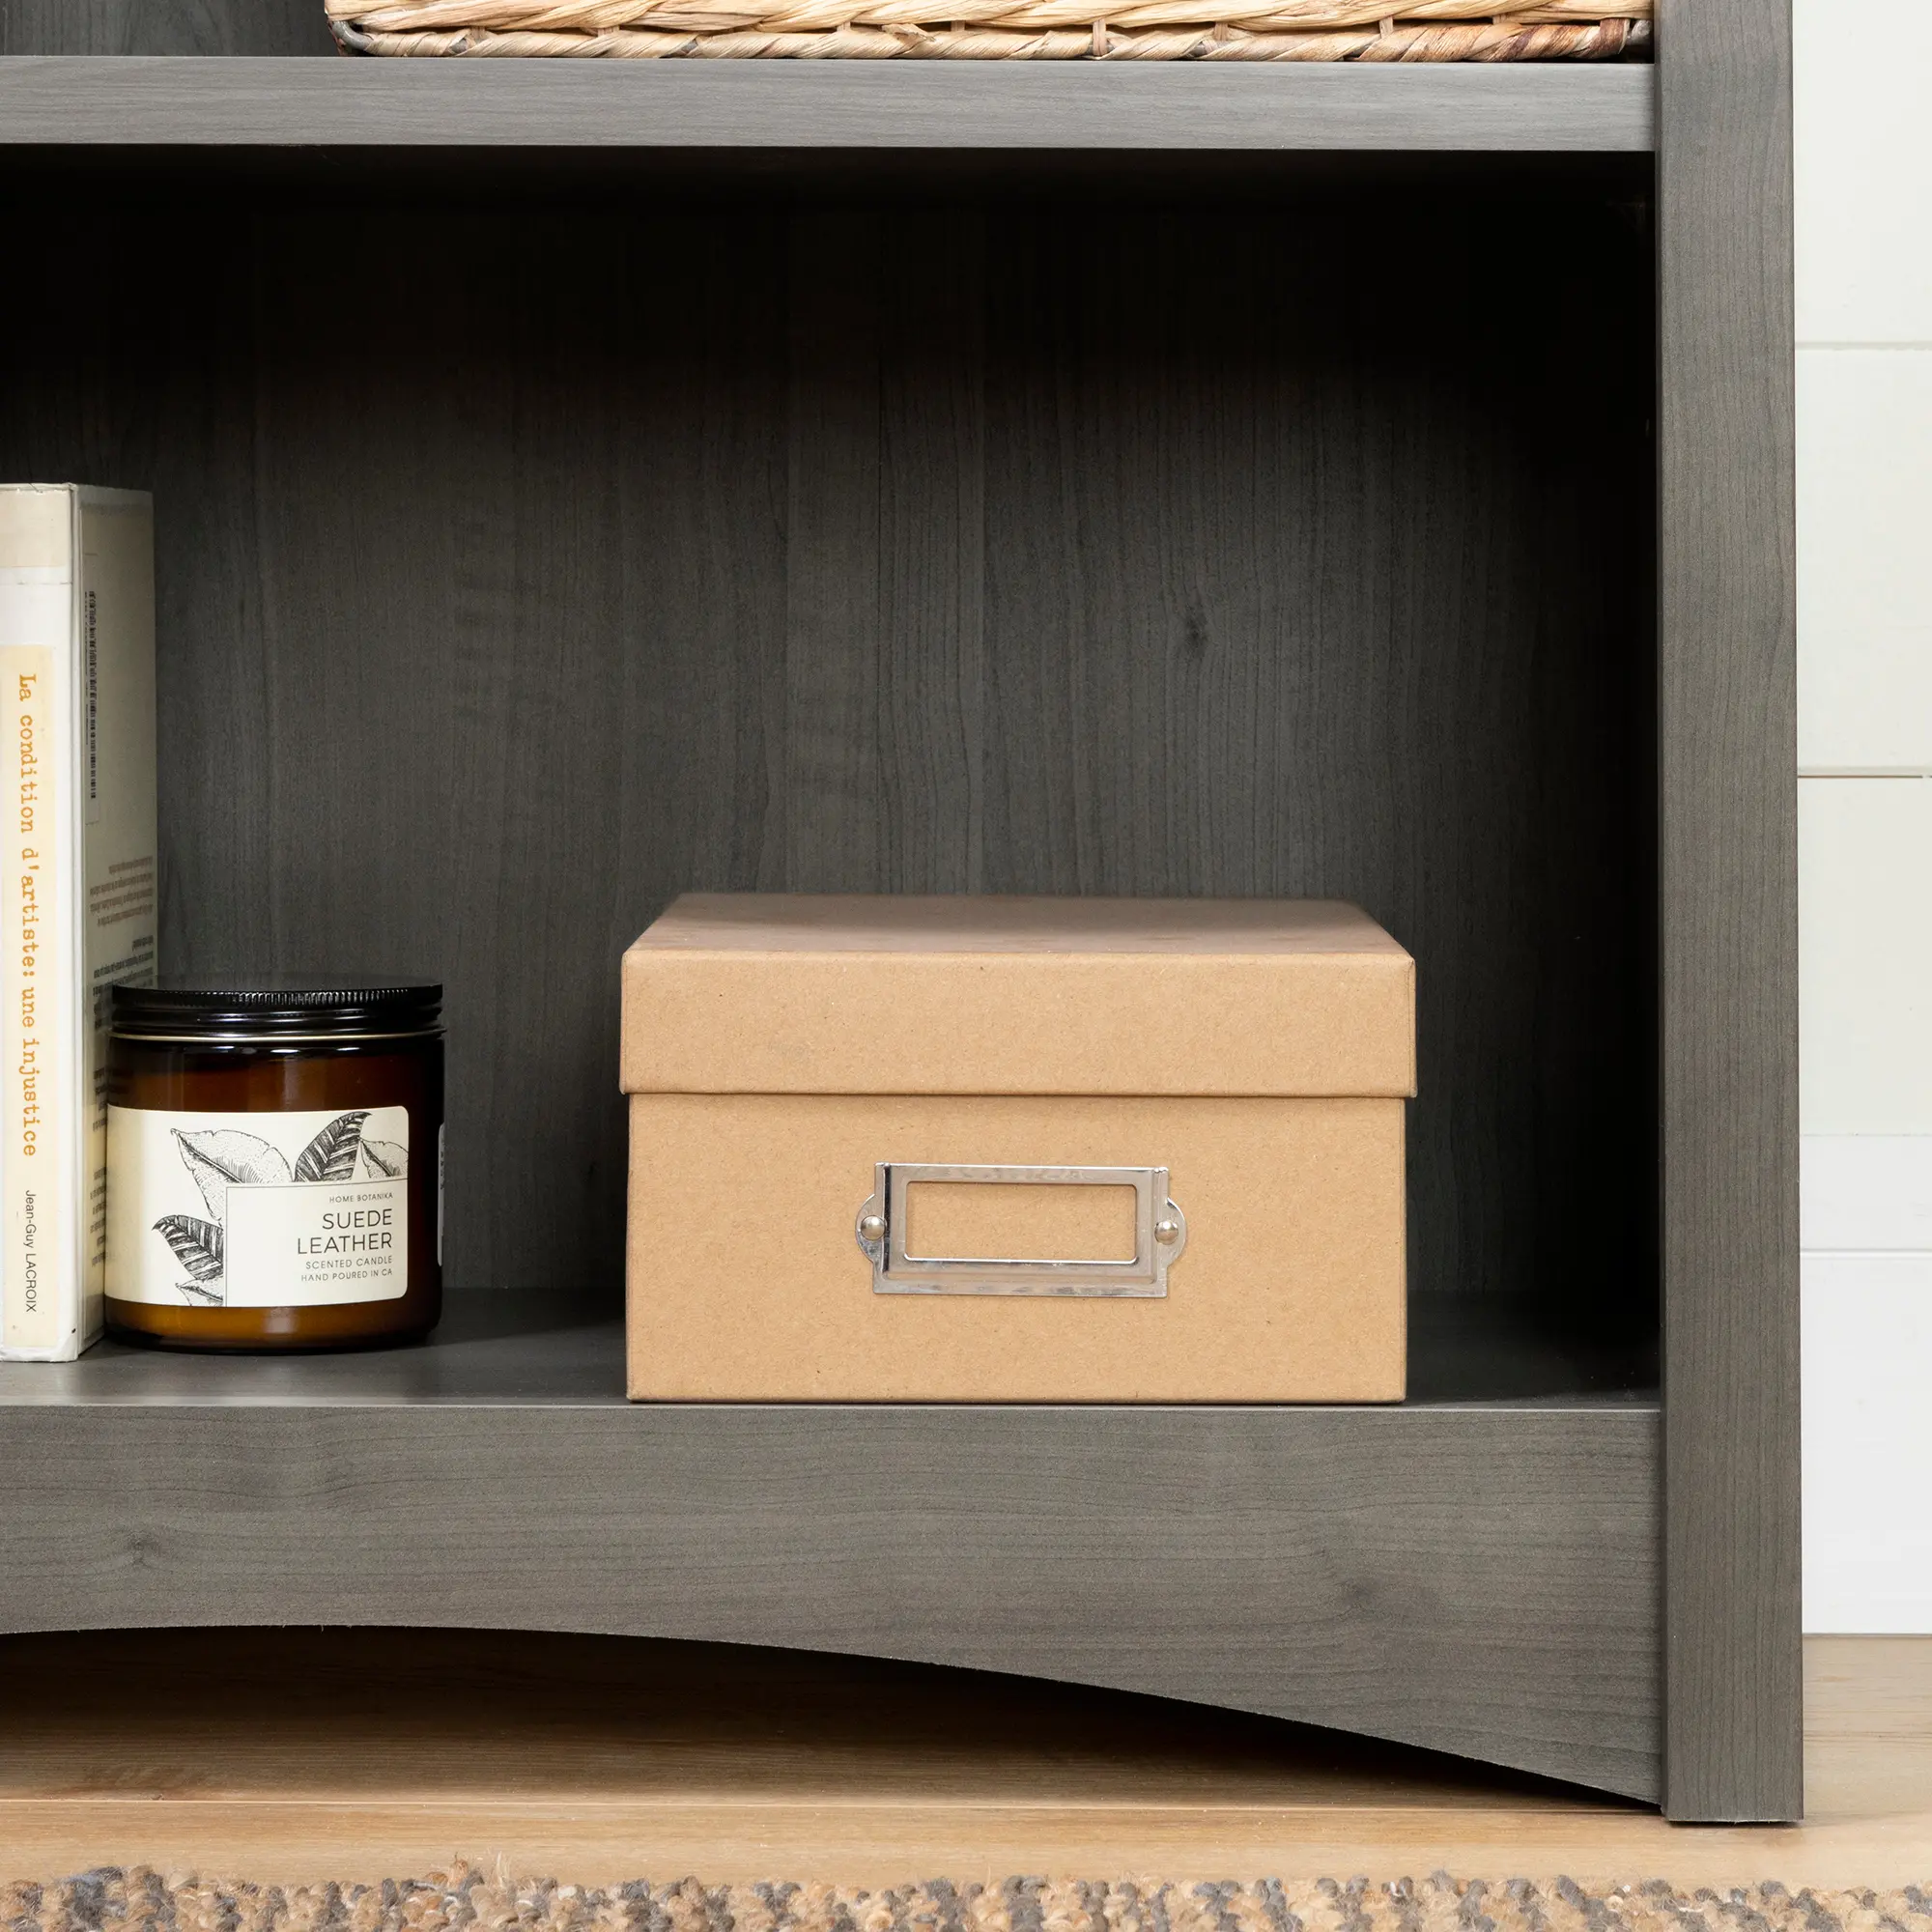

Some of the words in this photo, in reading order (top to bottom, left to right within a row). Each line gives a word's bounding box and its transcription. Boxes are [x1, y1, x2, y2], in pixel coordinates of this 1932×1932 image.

[18, 673, 38, 702] La
[19, 715, 38, 834] condition
[20, 847, 40, 977] d'artiste:
[21, 986, 37, 1029] une
[18, 1037, 42, 1157] injustice
[328, 1194, 355, 1204] HOME
[356, 1192, 394, 1202] BOTANIKA
[24, 1189, 37, 1249] Jean-Guy
[322, 1208, 393, 1230] SUEDE
[297, 1232, 392, 1255] LEATHER
[300, 1272, 329, 1282] HAND
[331, 1270, 368, 1280] POURED
[370, 1268, 380, 1277] IN
[381, 1267, 393, 1276] CA
[305, 1259, 353, 1270] SCENTED
[355, 1255, 393, 1267] CANDLE
[25, 1253, 38, 1313] LACROIX
